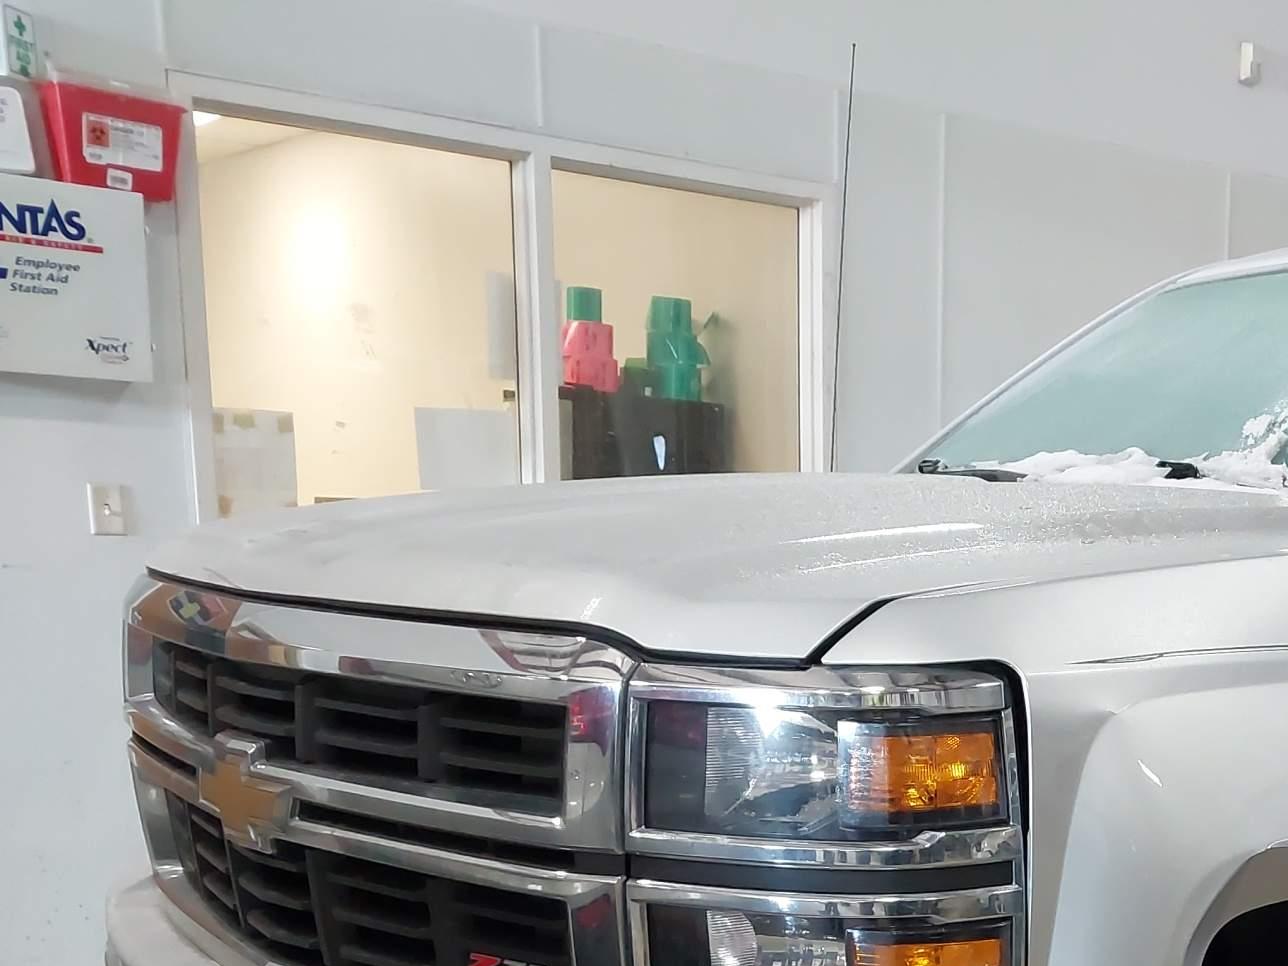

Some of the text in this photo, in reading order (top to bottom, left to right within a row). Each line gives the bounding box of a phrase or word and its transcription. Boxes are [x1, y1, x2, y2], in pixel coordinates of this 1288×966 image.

[15, 256, 81, 272] Employee
[12, 269, 69, 284] First Aid
[9, 282, 58, 295] Station
